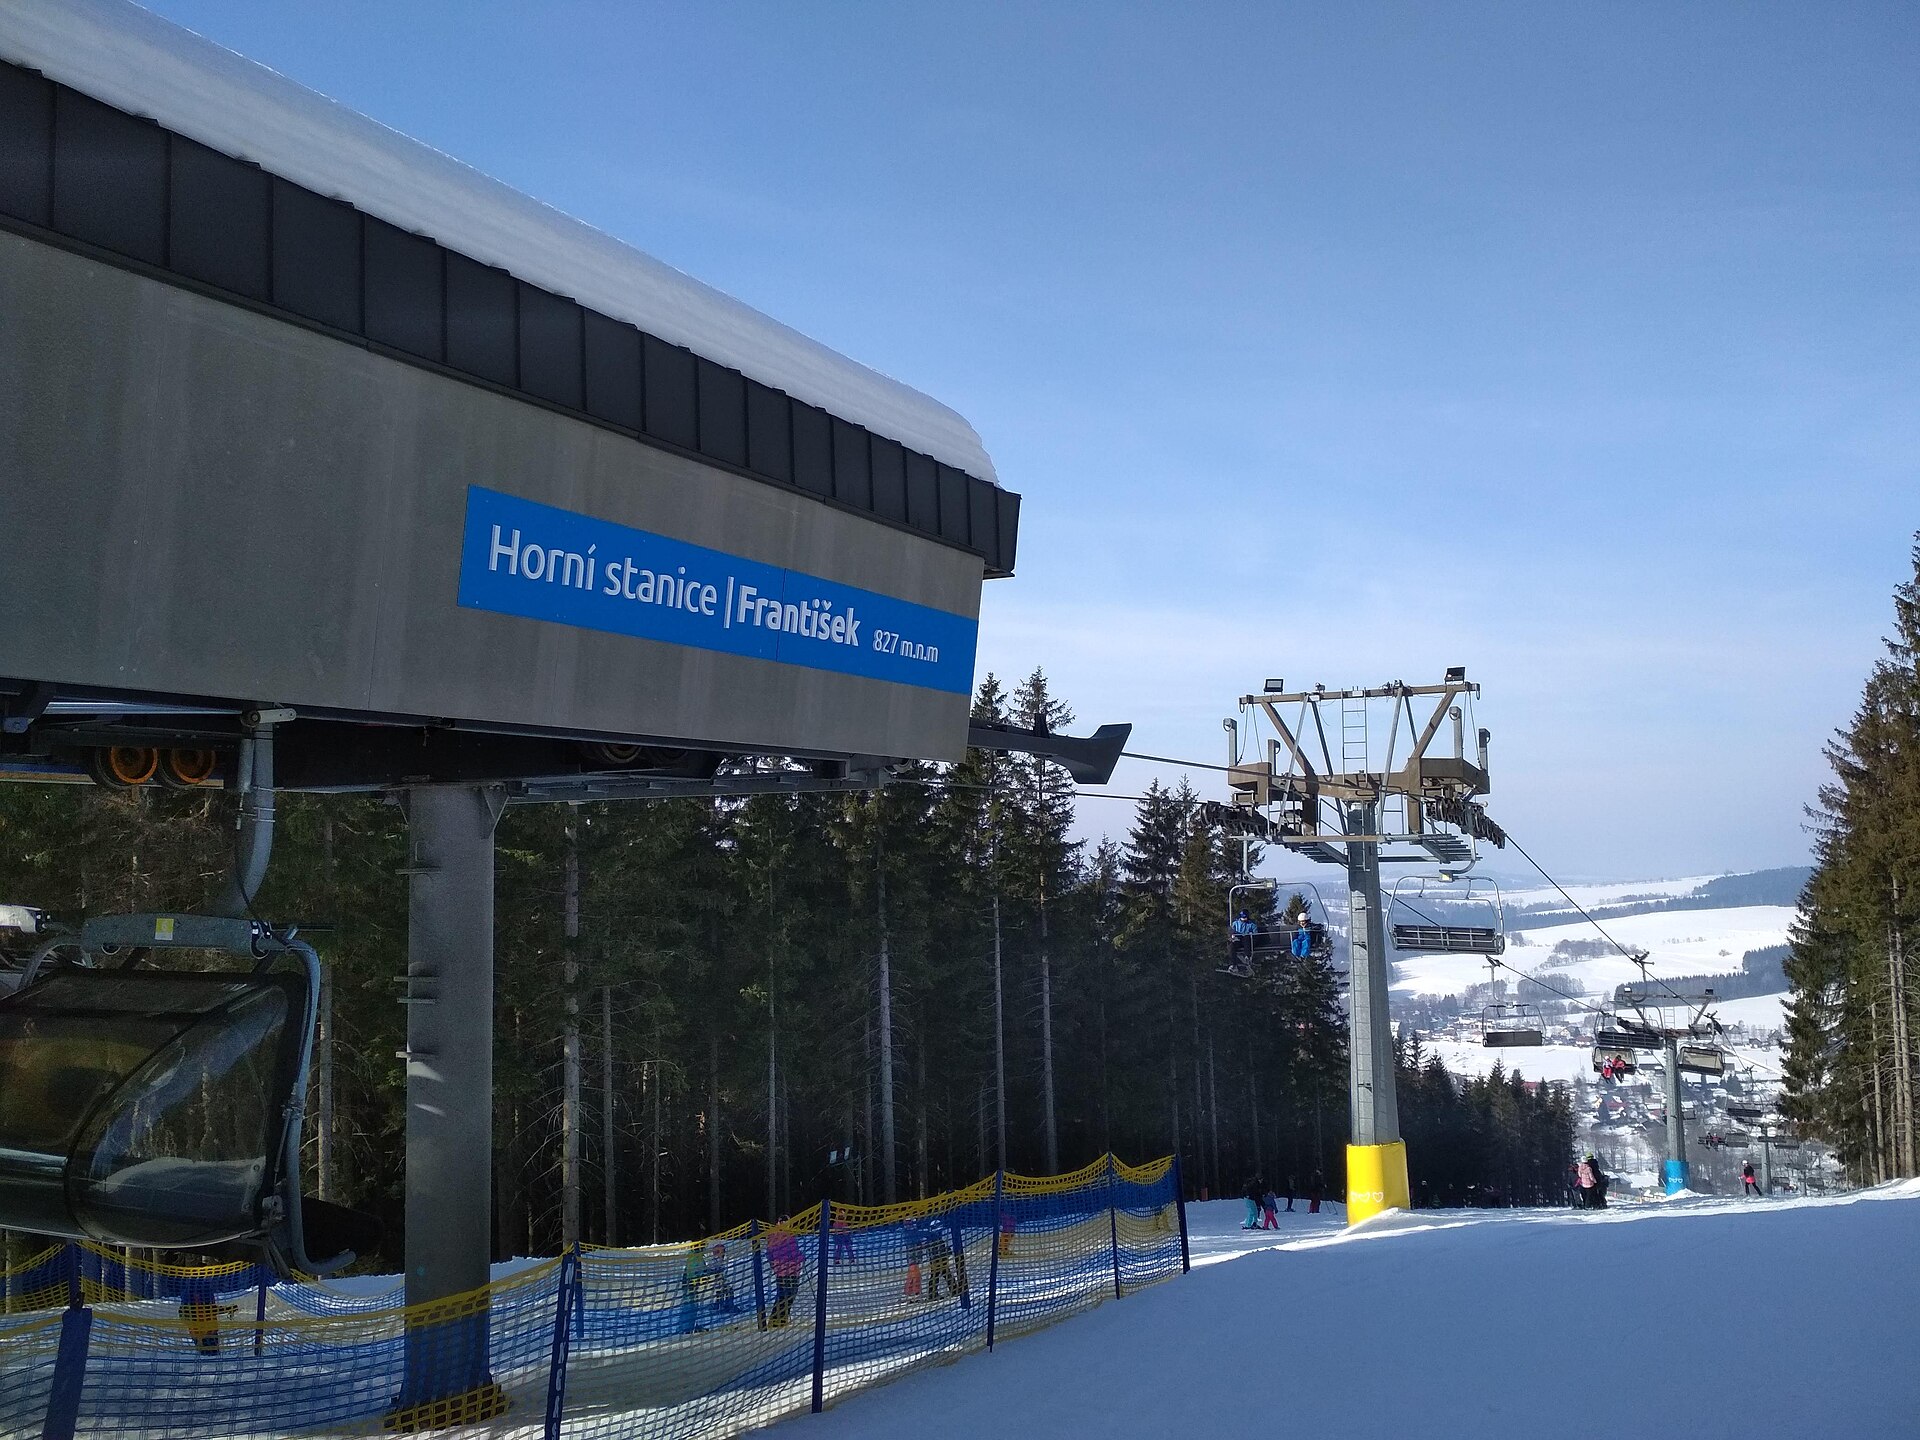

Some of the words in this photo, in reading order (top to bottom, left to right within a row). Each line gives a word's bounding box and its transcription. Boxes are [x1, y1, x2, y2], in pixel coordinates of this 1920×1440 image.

[488, 524, 597, 591] Horní
[603, 557, 718, 616] stanice
[872, 629, 900, 654] 827
[900, 640, 939, 663] m.n.m
